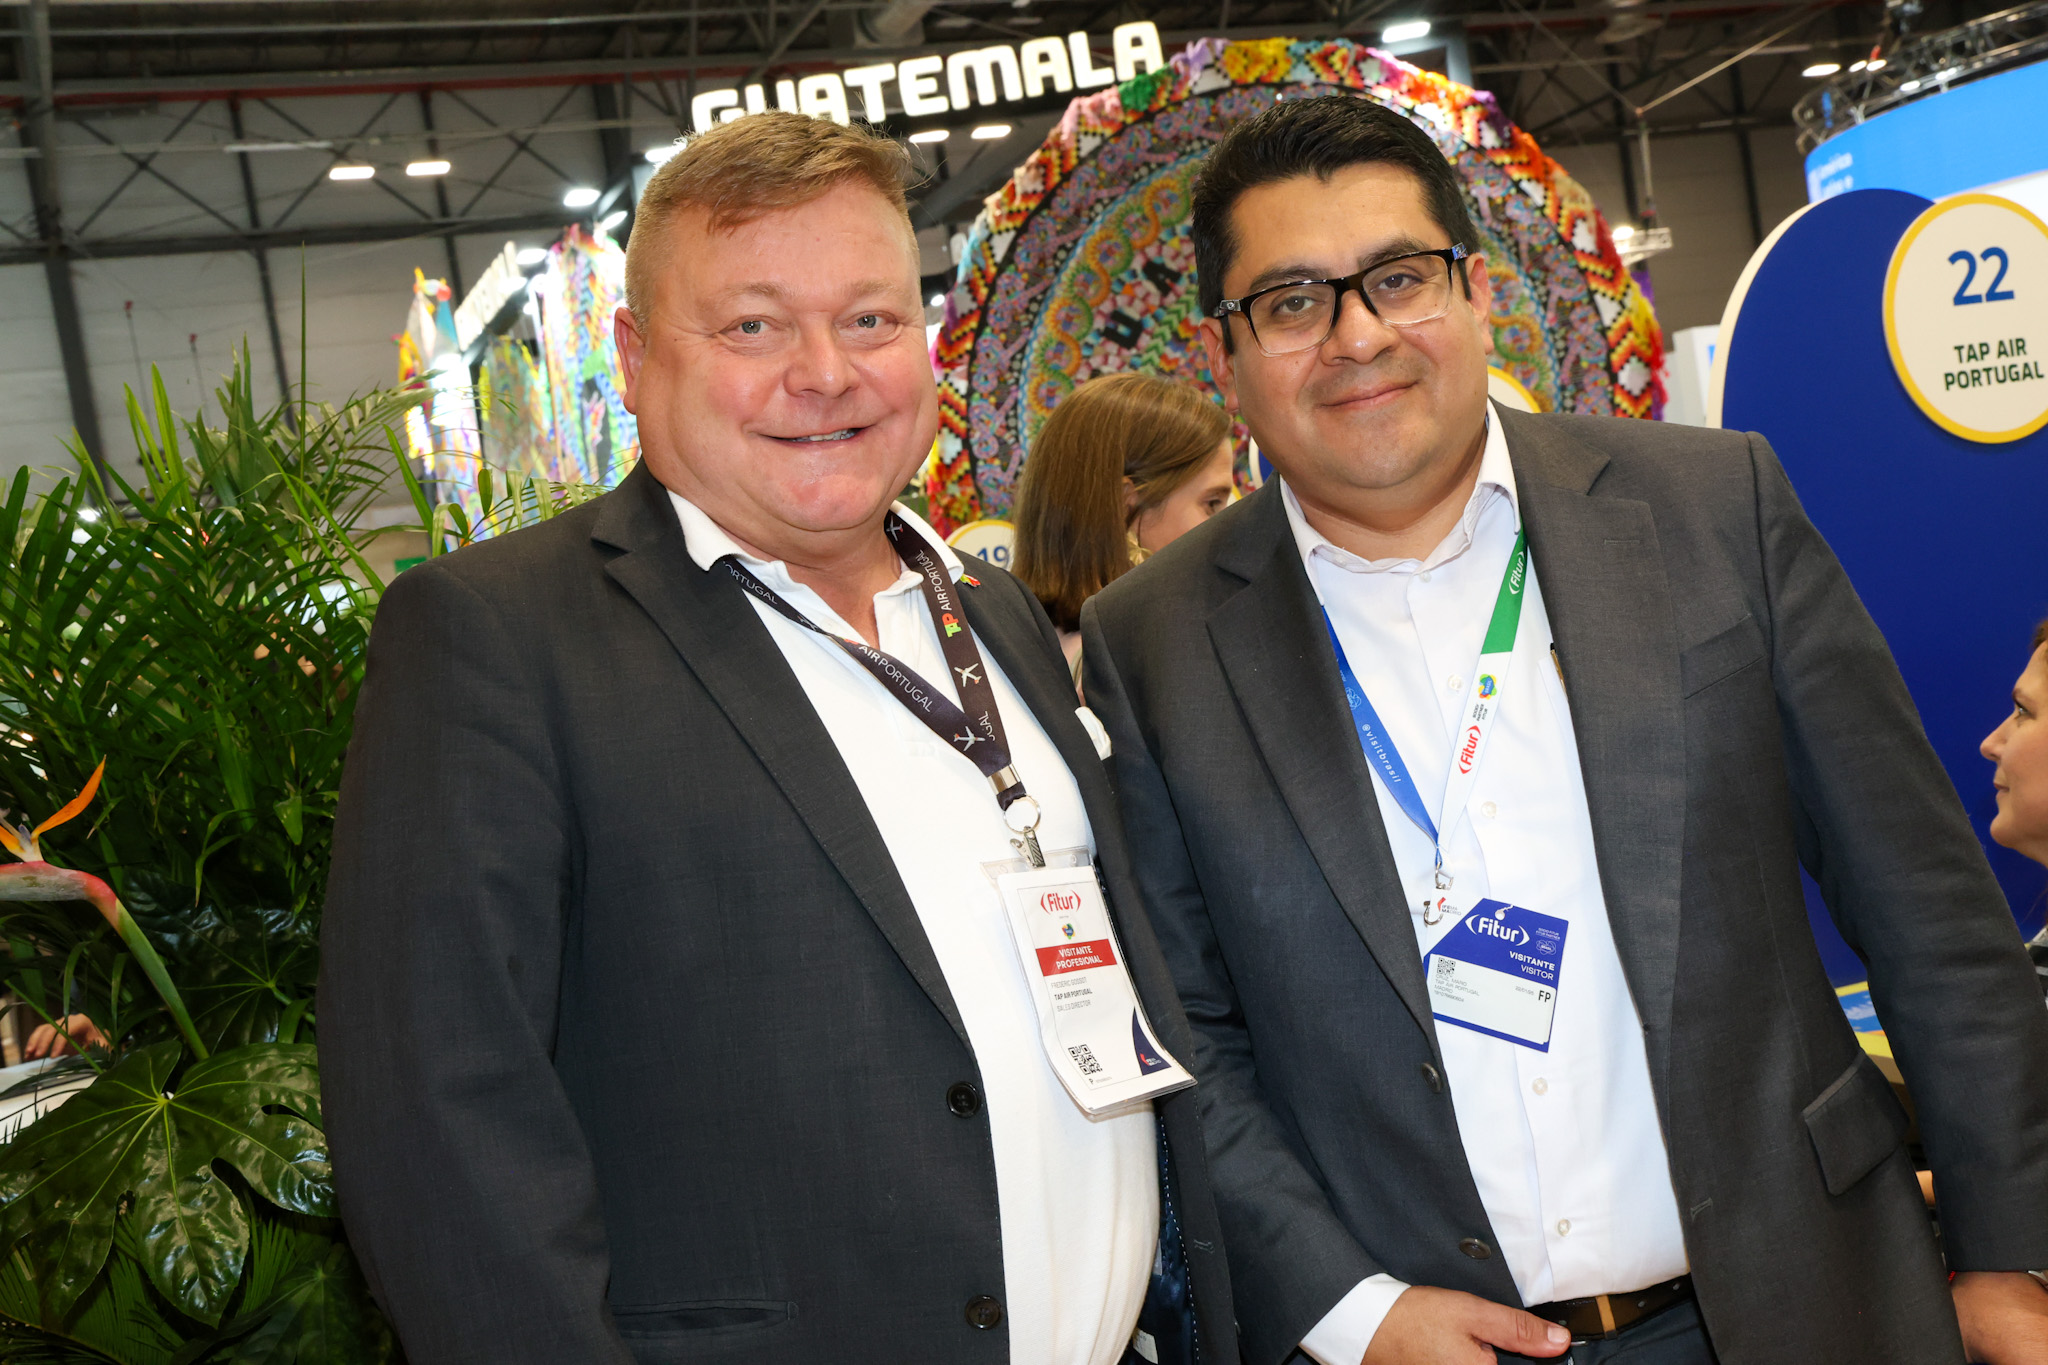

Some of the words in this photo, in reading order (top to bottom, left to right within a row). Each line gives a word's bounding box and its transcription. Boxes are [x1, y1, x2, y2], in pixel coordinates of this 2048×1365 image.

[691, 21, 1164, 128] GUATEMALA
[1948, 246, 2015, 306] 22
[1954, 342, 1990, 364] TAP
[1997, 337, 2027, 359] AIR
[1944, 361, 2045, 391] PORTUGAL
[723, 561, 778, 605] RTUGAL
[1362, 723, 1402, 783] @visitbrasil
[1056, 955, 1103, 970] PROFESIONAL
[1058, 945, 1093, 957] VISITANTE
[1509, 950, 1556, 971] VISITANTE
[1521, 964, 1554, 980] VISITOR
[1538, 990, 1551, 1003] FP
